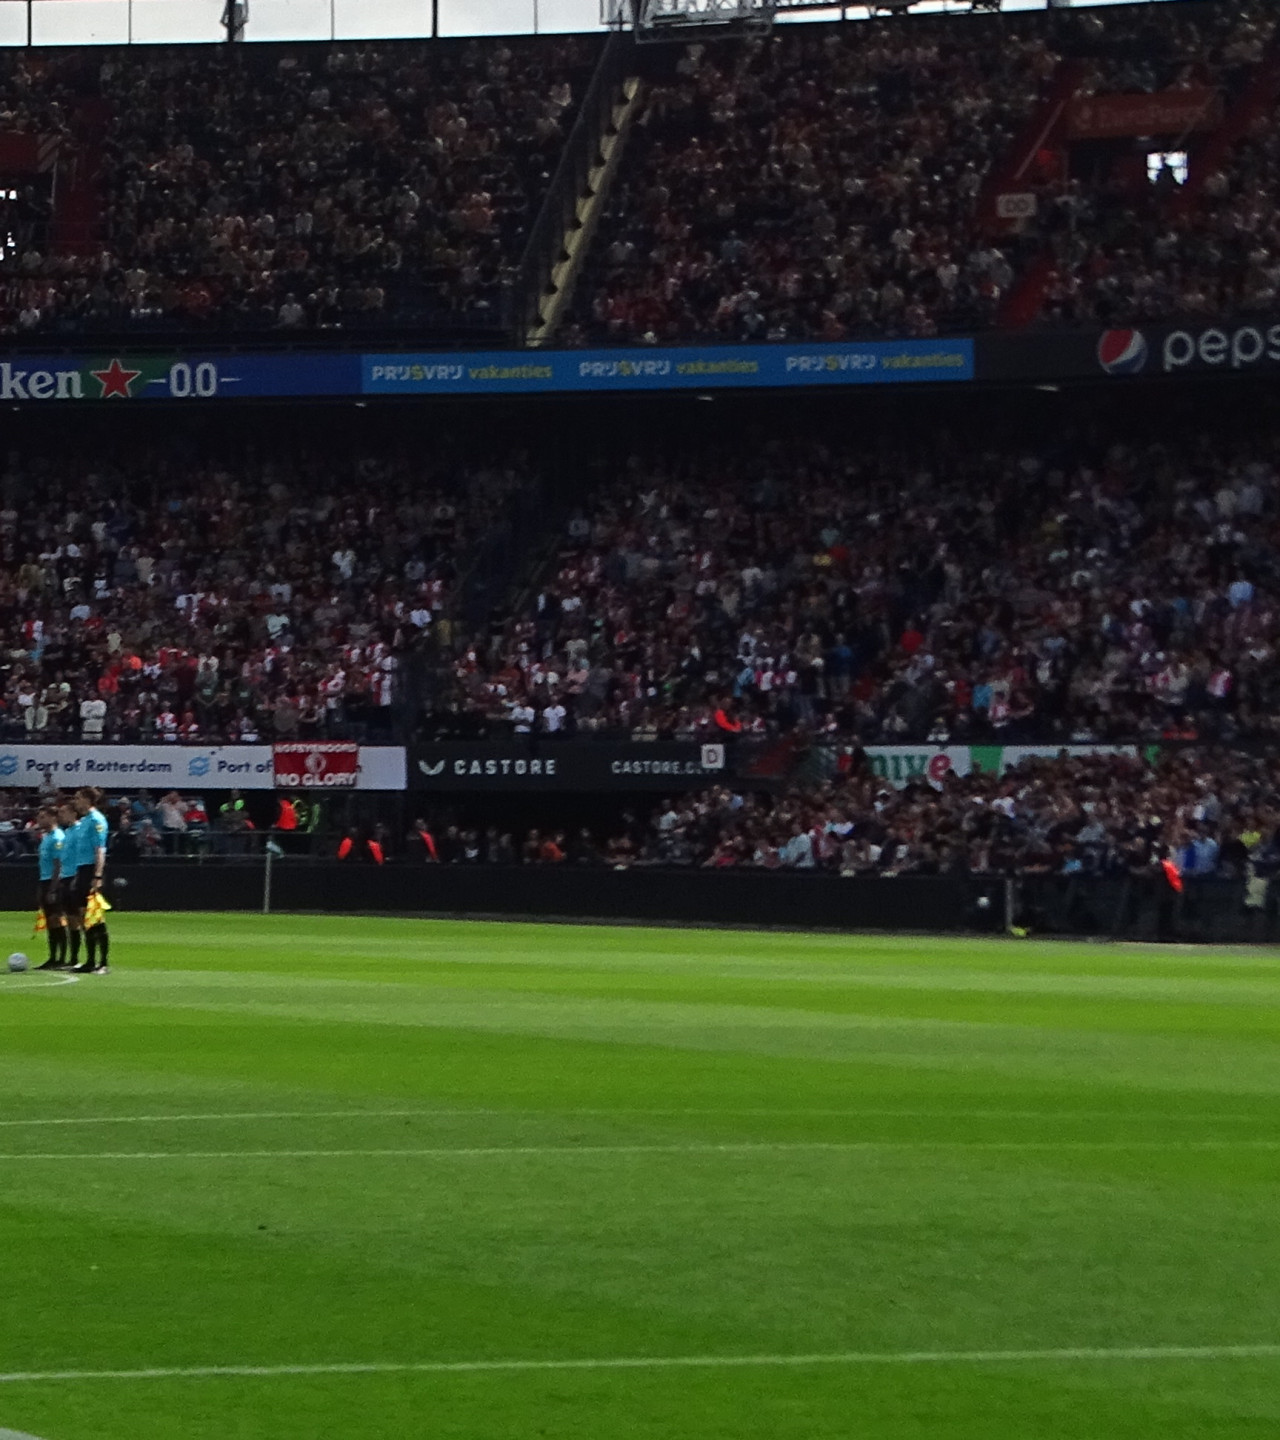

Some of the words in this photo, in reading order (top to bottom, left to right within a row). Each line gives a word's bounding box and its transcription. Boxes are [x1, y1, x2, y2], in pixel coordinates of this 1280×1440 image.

[706, 748, 718, 764] D
[26, 759, 59, 772] Port
[64, 758, 81, 772] of
[86, 758, 173, 773] Rotterdam
[218, 760, 251, 773] Port
[454, 759, 557, 776] CASTORE
[611, 759, 720, 775] CASTORE.C
[275, 773, 301, 786] NO
[301, 772, 357, 787] GLORY
